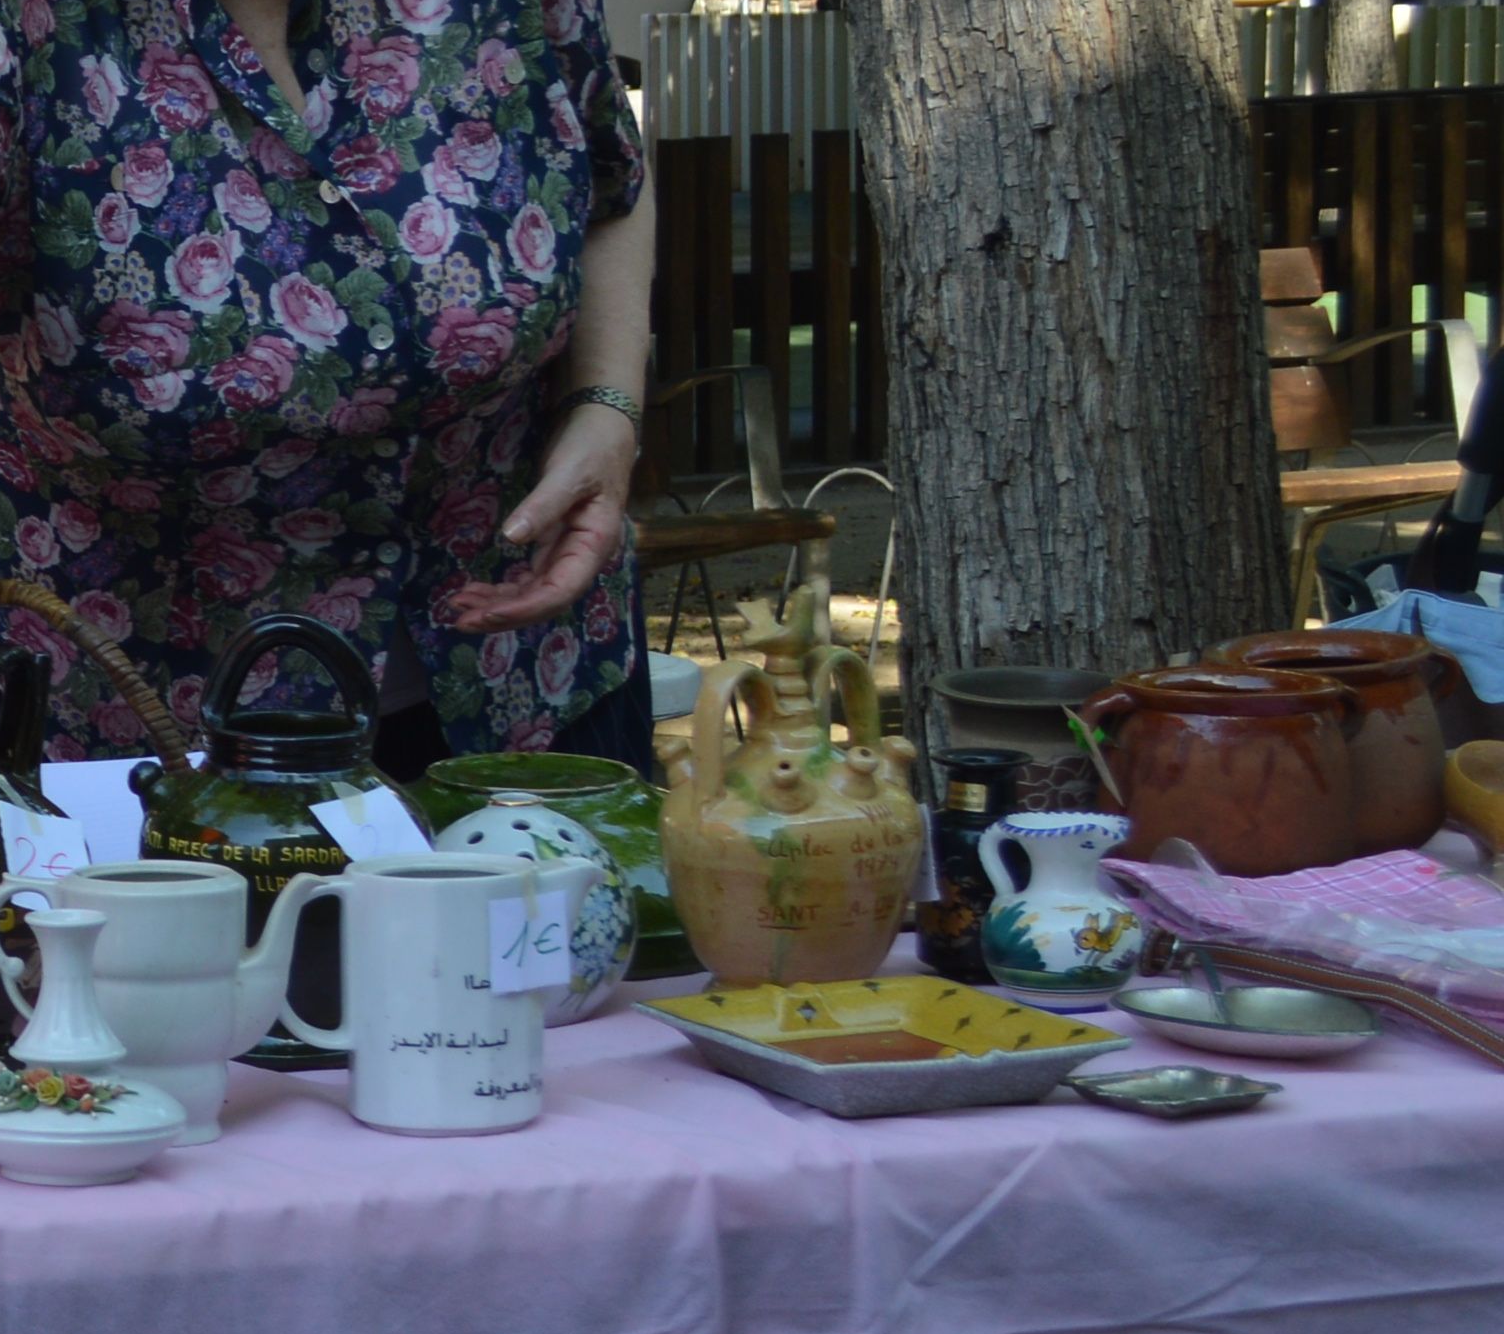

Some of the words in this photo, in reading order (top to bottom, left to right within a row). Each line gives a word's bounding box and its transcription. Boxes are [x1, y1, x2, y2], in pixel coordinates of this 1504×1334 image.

[223, 844, 244, 862] DE
[251, 847, 270, 865] LA
[280, 846, 346, 865] SARDA
